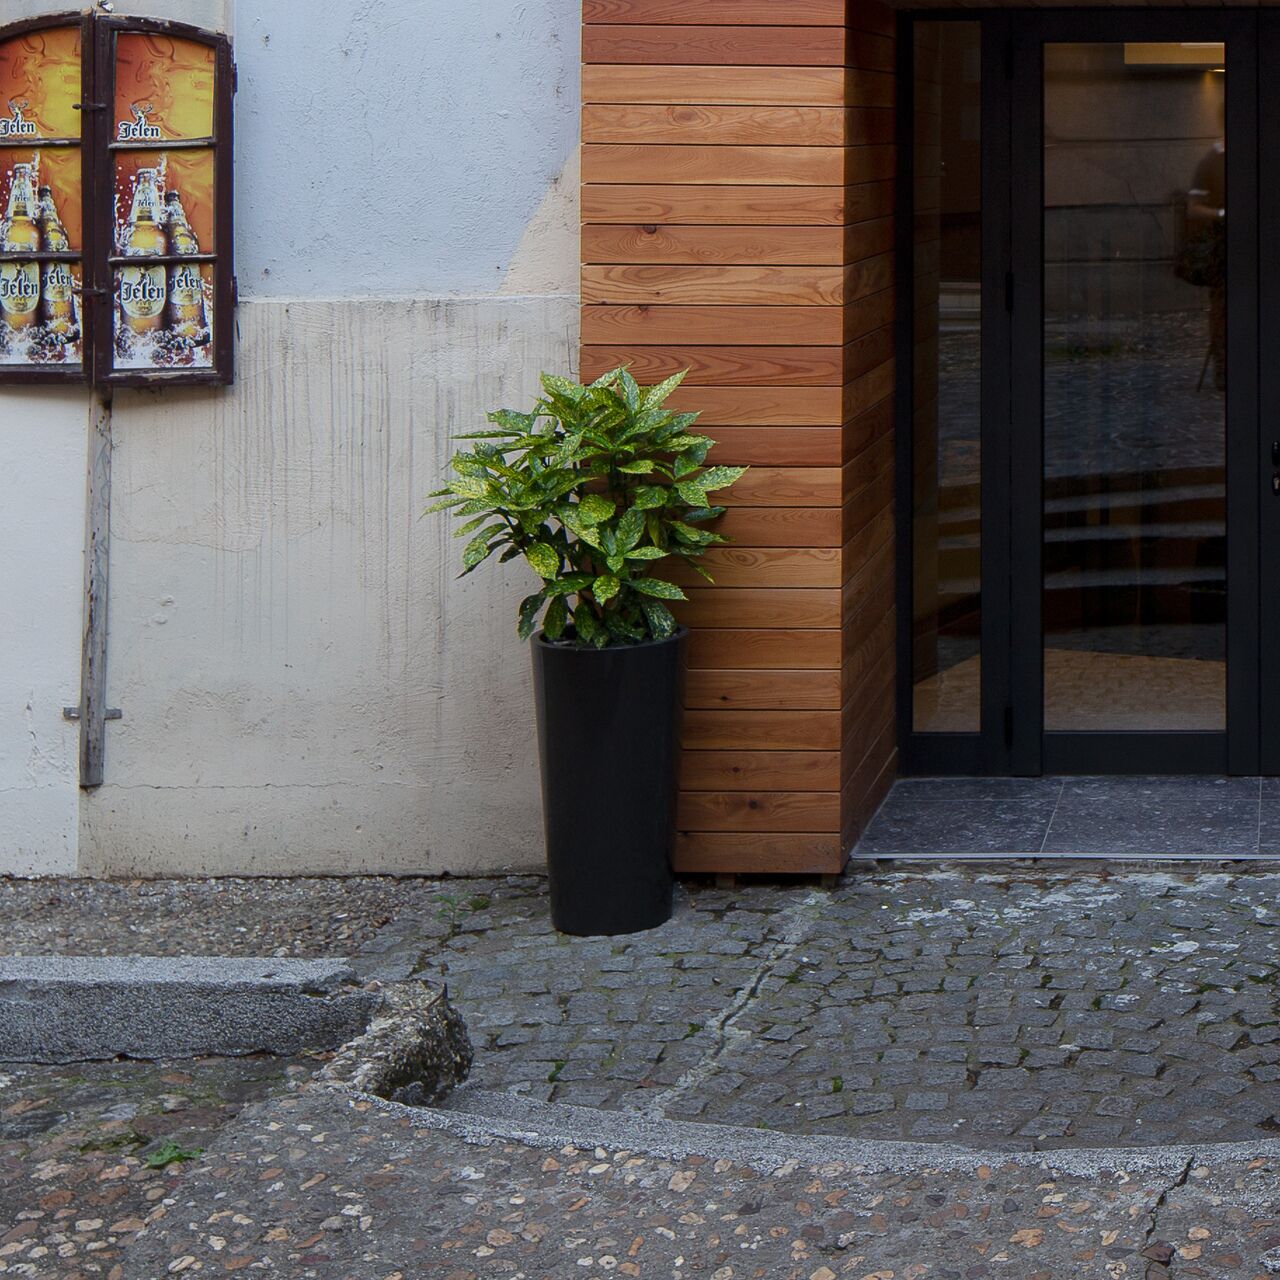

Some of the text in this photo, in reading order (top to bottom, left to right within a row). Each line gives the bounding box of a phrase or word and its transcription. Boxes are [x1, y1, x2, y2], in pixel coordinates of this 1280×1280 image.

[0, 120, 35, 136] Jelen
[119, 122, 160, 139] Jelen
[0, 277, 38, 297] Jelen
[43, 270, 73, 288] Jelen
[170, 274, 203, 291] Jelen
[122, 280, 164, 302] Jelen
